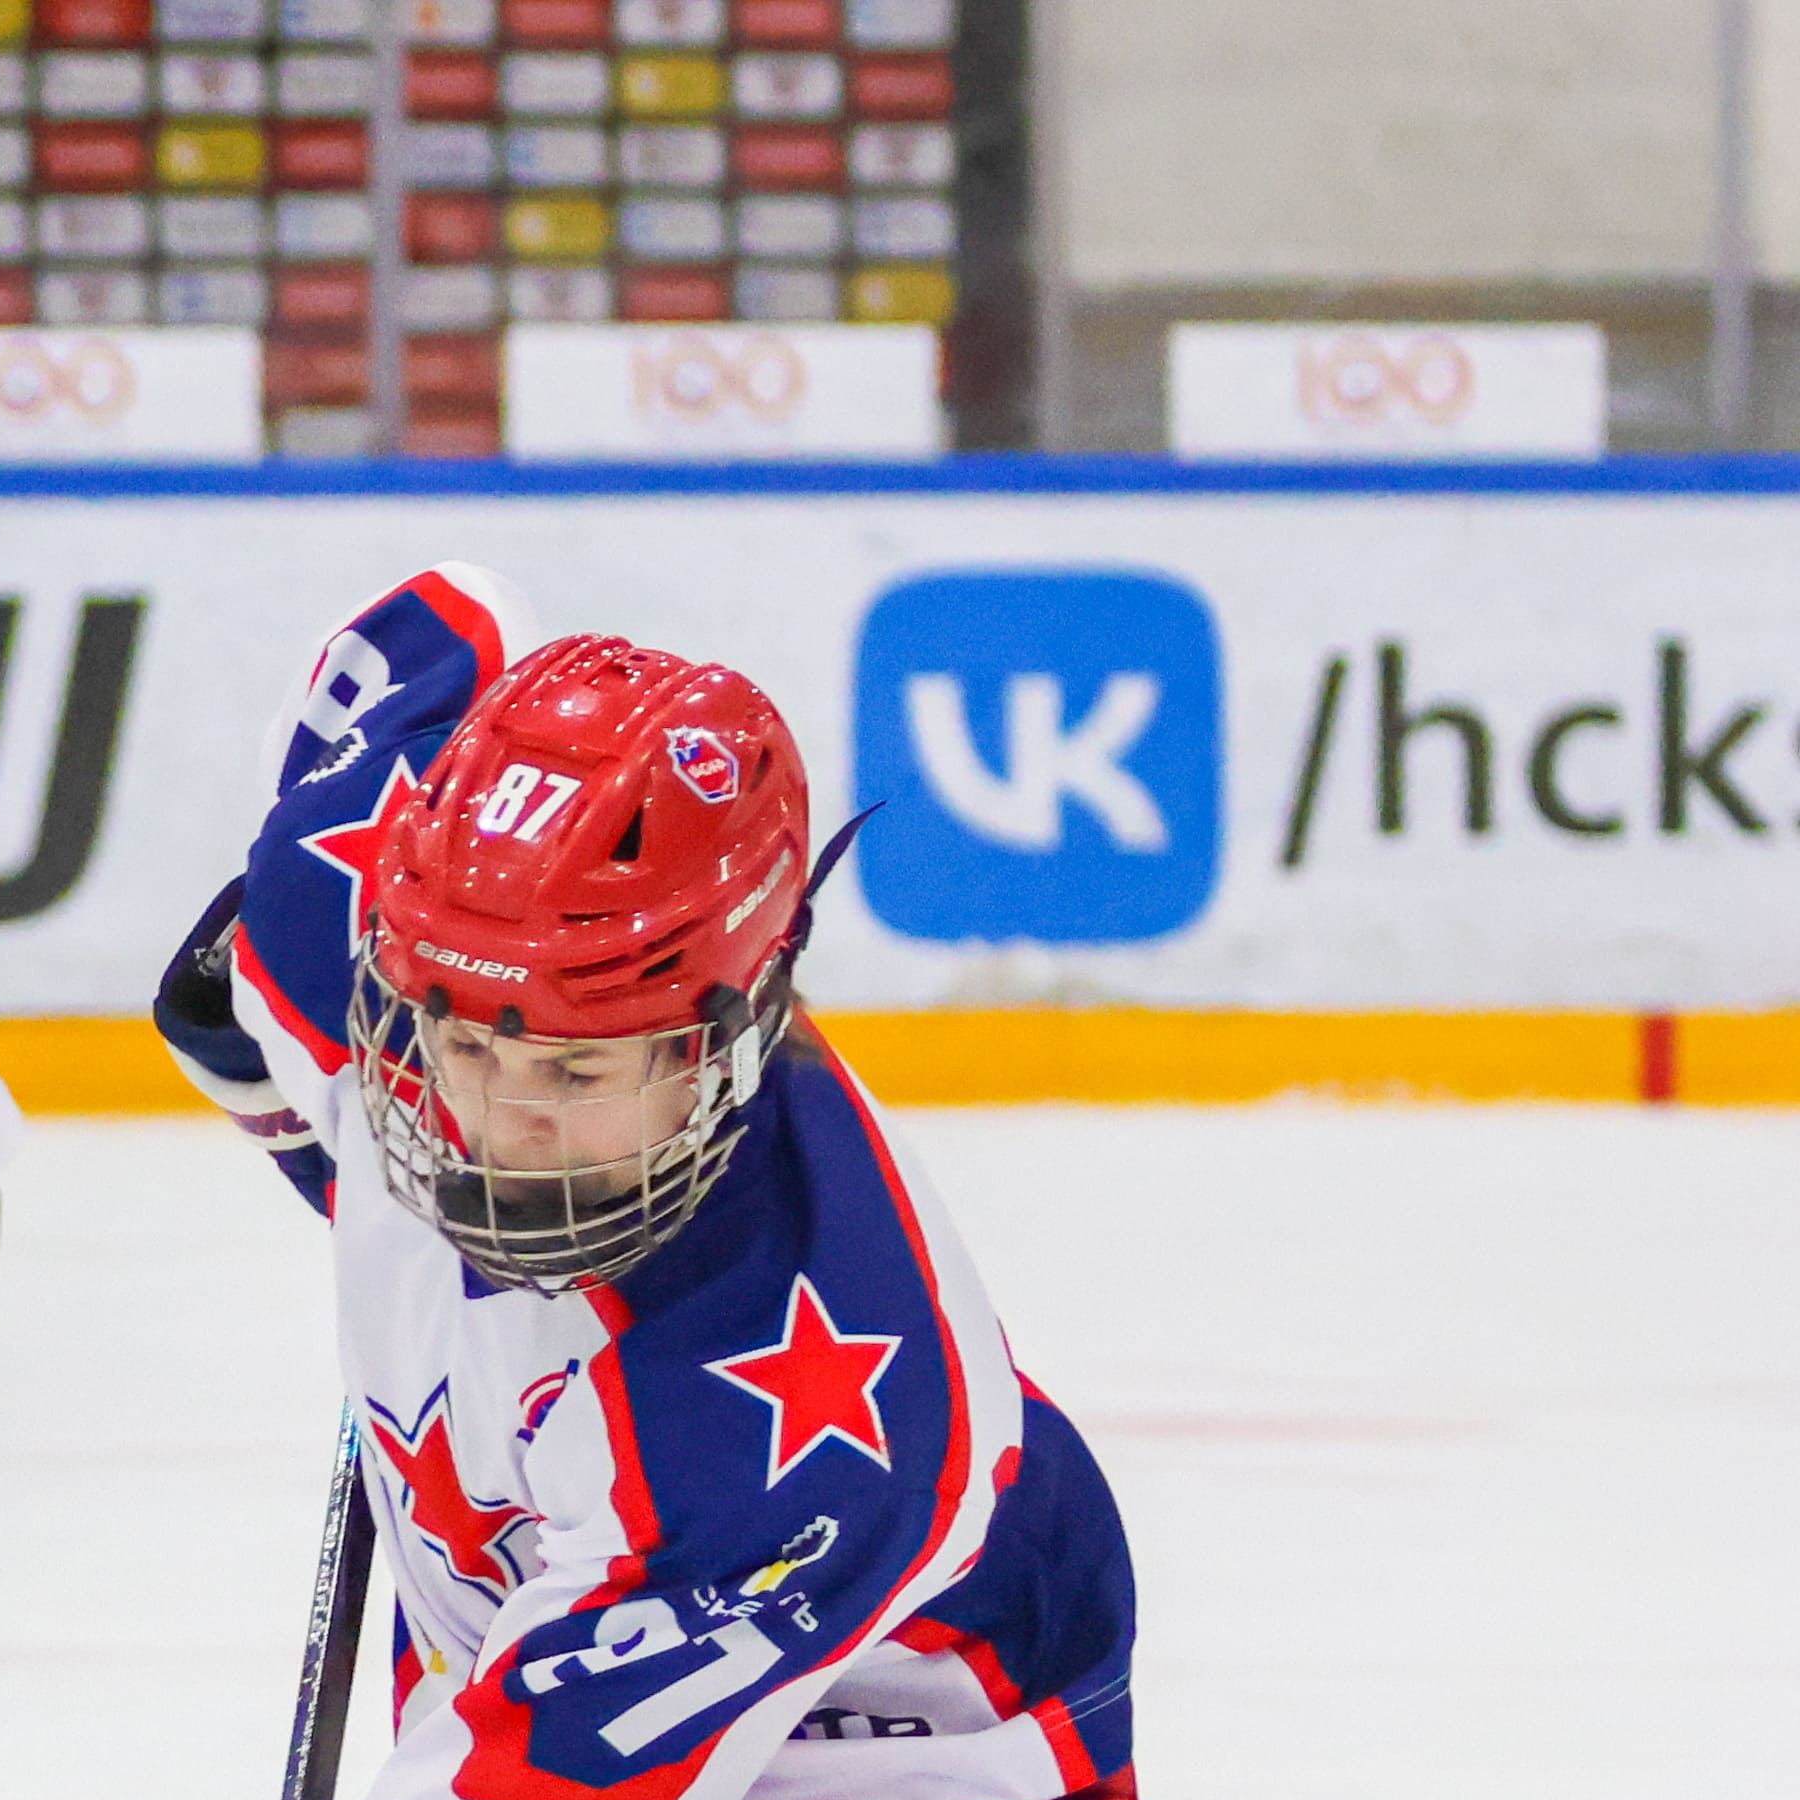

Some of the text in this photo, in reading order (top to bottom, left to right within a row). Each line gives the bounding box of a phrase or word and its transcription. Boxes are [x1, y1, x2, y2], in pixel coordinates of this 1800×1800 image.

[475, 762, 584, 844] 87
[902, 670, 1170, 856] VK
[1276, 634, 1800, 878] /hck
[413, 939, 531, 983] BAUER
